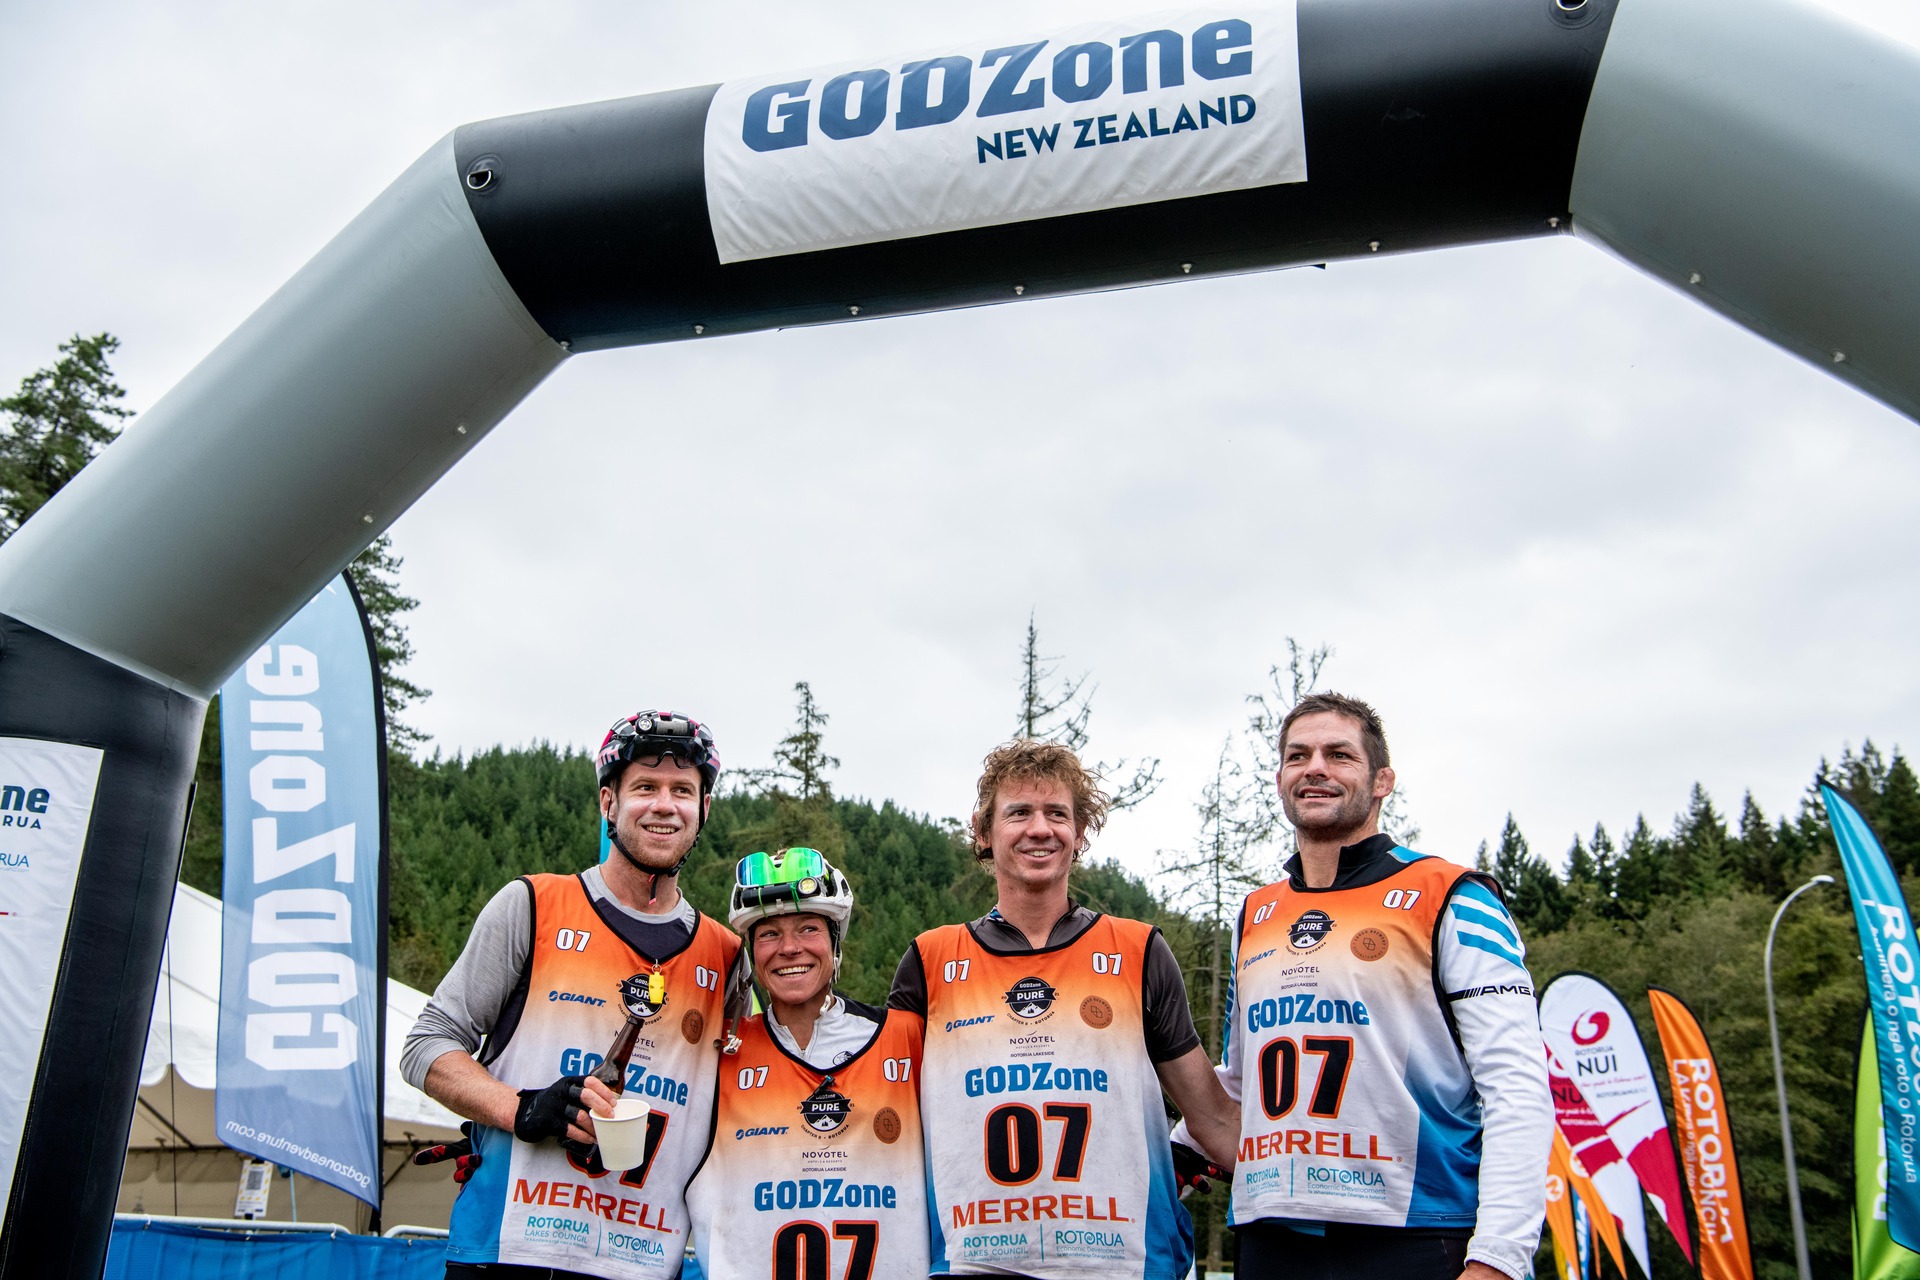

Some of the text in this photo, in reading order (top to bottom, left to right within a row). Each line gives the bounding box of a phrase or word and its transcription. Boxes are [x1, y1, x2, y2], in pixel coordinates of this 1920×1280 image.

[742, 19, 1252, 152] GODZone
[977, 94, 1257, 163] NEW ZEALAND
[1382, 889, 1421, 910] 07
[1252, 899, 1278, 925] 07
[1297, 923, 1324, 932] PURE
[556, 928, 591, 952] 07
[944, 958, 970, 983] 07
[1092, 952, 1122, 976] 07
[1281, 966, 1320, 976] NOVOTEL
[695, 965, 719, 992] 07
[558, 993, 607, 1007] GIANT
[630, 986, 650, 1000] PUR
[1016, 990, 1045, 1001] PURE
[1480, 985, 1532, 996] AMG
[951, 1015, 996, 1029] GIANT
[1248, 994, 1370, 1033] GODZone
[614, 1030, 655, 1048] NOTEL
[1009, 1036, 1055, 1045] NOVOTEL
[1887, 1021, 1906, 1054] ngā
[883, 1057, 911, 1082] 07
[1577, 1054, 1617, 1076] NUI
[1896, 1056, 1911, 1093] roto
[560, 1048, 688, 1107] GOZone
[738, 1066, 769, 1090] 07
[965, 1062, 1108, 1098] GODZone
[1258, 1035, 1354, 1121] 07
[1552, 1087, 1584, 1104] NU
[1898, 1097, 1911, 1109] o
[812, 1102, 840, 1112] PURE
[745, 1126, 790, 1138] GIANT
[984, 1101, 1092, 1187] 07
[1237, 1130, 1393, 1162] MERRELL
[1900, 1113, 1918, 1184] Rotorua
[802, 1151, 848, 1159] NOVOTEL
[1246, 1167, 1280, 1185] ROTORUA
[1307, 1167, 1386, 1187] ROTORUA
[754, 1178, 897, 1211] GODZone
[1342, 1185, 1386, 1194] Development
[513, 1179, 673, 1234] MERRELL
[952, 1194, 1129, 1229] MERRELL
[527, 1216, 590, 1235] ROTORUA
[524, 1229, 550, 1238] LAKES
[552, 1230, 588, 1244] COUNCIL
[608, 1231, 665, 1257] ROTORUA
[963, 1233, 1028, 1249] ROTORUA
[1055, 1230, 1125, 1247] ROTORUA
[772, 1219, 880, 1280] 07
[963, 1247, 1029, 1257] LAKES COUNCIL
[1056, 1245, 1125, 1254] Economic Development
